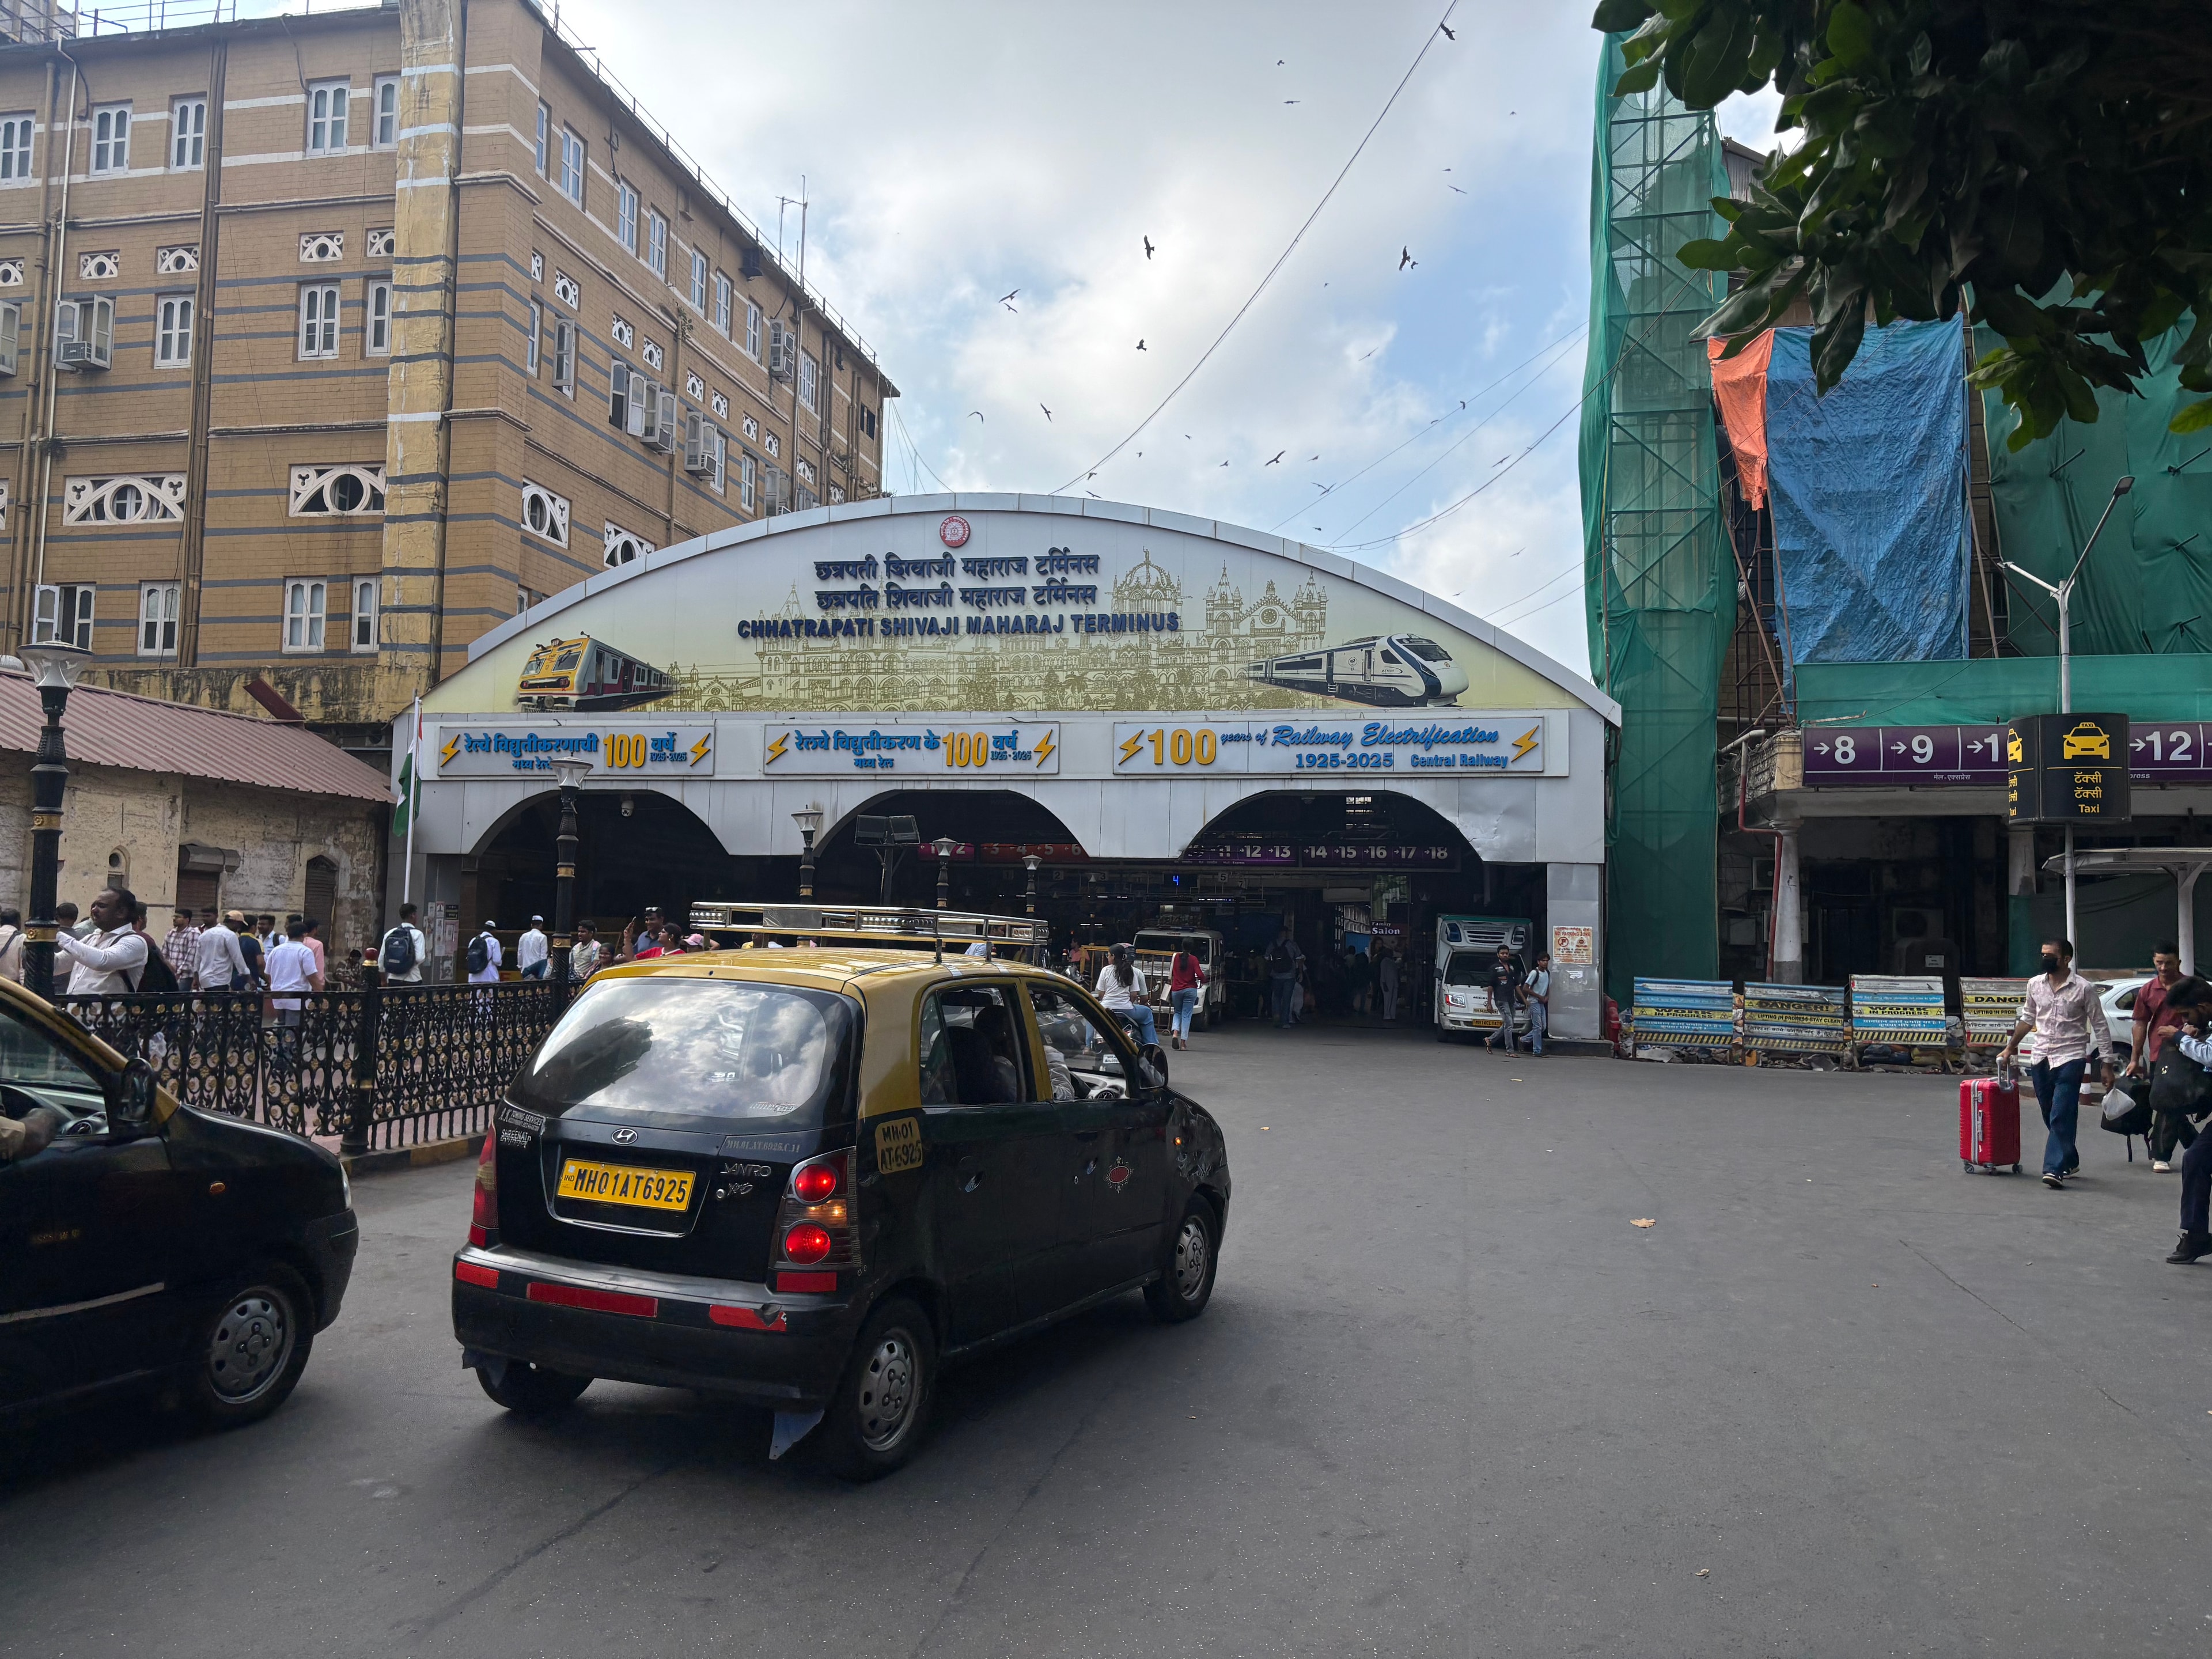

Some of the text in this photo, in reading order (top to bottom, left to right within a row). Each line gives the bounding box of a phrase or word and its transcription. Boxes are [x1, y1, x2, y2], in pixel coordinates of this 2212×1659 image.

[813, 547, 1100, 581] छत्रपती शिवाजी महाराज टर्मिनस
[815, 577, 1098, 611] छत्रपति शिवाजी महाराज टर्मिनस
[737, 612, 1179, 639] CHHATRAPATI SHIVAJI MAHARAJ TERMINUS
[464, 732, 677, 767] रेल्वे विद्युतीकरणाची 100 वर्षे
[794, 729, 1018, 767] रेलवे विद्युतीकरण के 100 वर्ष
[1147, 722, 1499, 765] 100 years of Railway Electrification
[1834, 736, 1856, 764] 8
[1911, 734, 1934, 764] 9
[2146, 731, 2192, 760] 12
[512, 759, 533, 770] मध्य
[854, 754, 894, 768] मध्य रेल
[1295, 752, 1509, 768] 1925-2025 Central Railway
[2074, 771, 2103, 783] टॅक्सी
[2074, 786, 2103, 798] टॅक्सी
[2078, 804, 2100, 813] Taxi
[956, 843, 965, 854] 2
[1016, 844, 1027, 855] 4
[1044, 844, 1054, 855] 5
[1071, 844, 1081, 855] 6
[1244, 846, 1262, 857] 12
[1274, 846, 1290, 858] 13
[1309, 846, 1448, 859] 14 15 16 17 18
[1054, 872, 1060, 880] 2
[1172, 875, 1179, 886] 4
[574, 1169, 687, 1203] MH01AT6925
